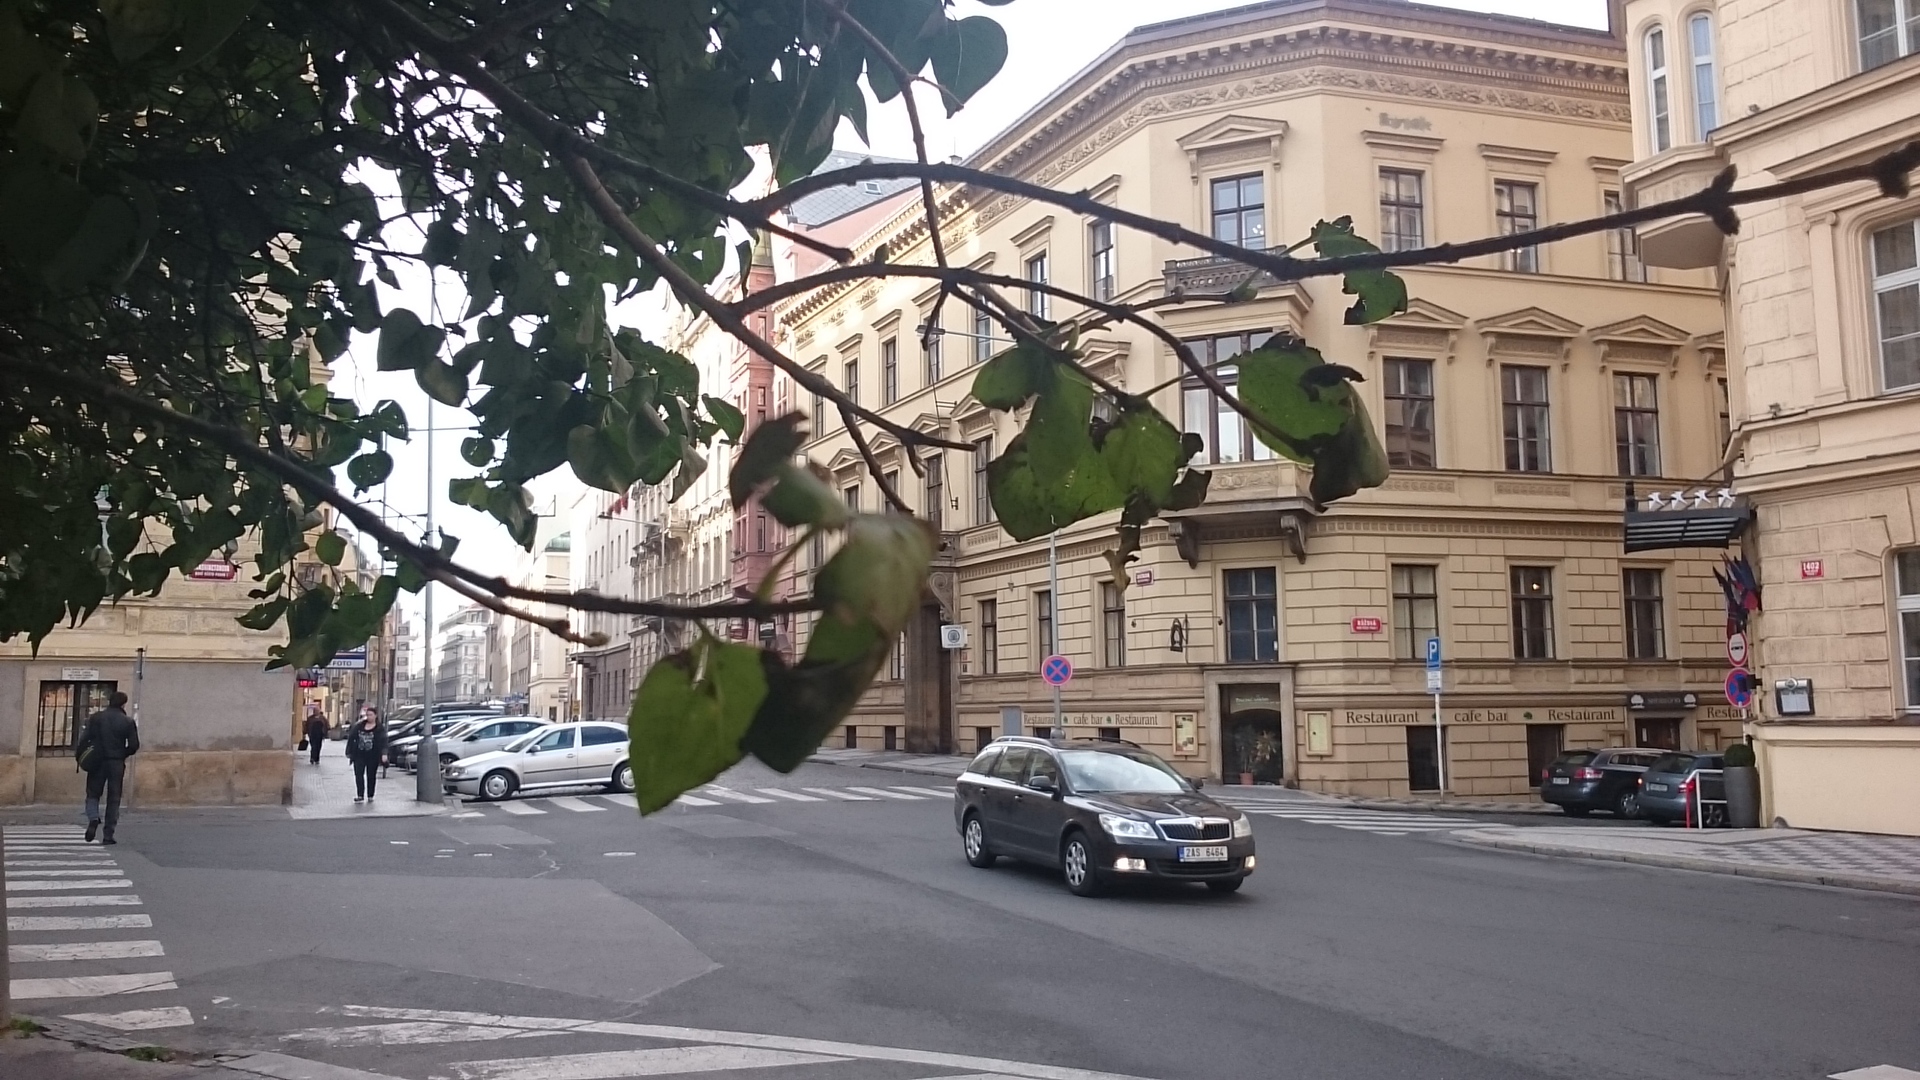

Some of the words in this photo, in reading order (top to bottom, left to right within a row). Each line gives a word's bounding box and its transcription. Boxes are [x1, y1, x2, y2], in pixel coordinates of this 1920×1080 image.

[1429, 641, 1438, 660] P
[1346, 711, 1420, 724] Restaurant
[1454, 709, 1482, 723] cafe
[1487, 709, 1508, 723] bar
[1548, 709, 1615, 721] Restaurant
[1707, 707, 1753, 718] Restaur
[1024, 714, 1056, 725] Restauran
[1073, 713, 1089, 725] cafe
[1091, 713, 1103, 725] bar
[1115, 713, 1158, 726] Restaurant
[1186, 848, 1201, 857] 2AS
[1206, 847, 1224, 857] 6464
